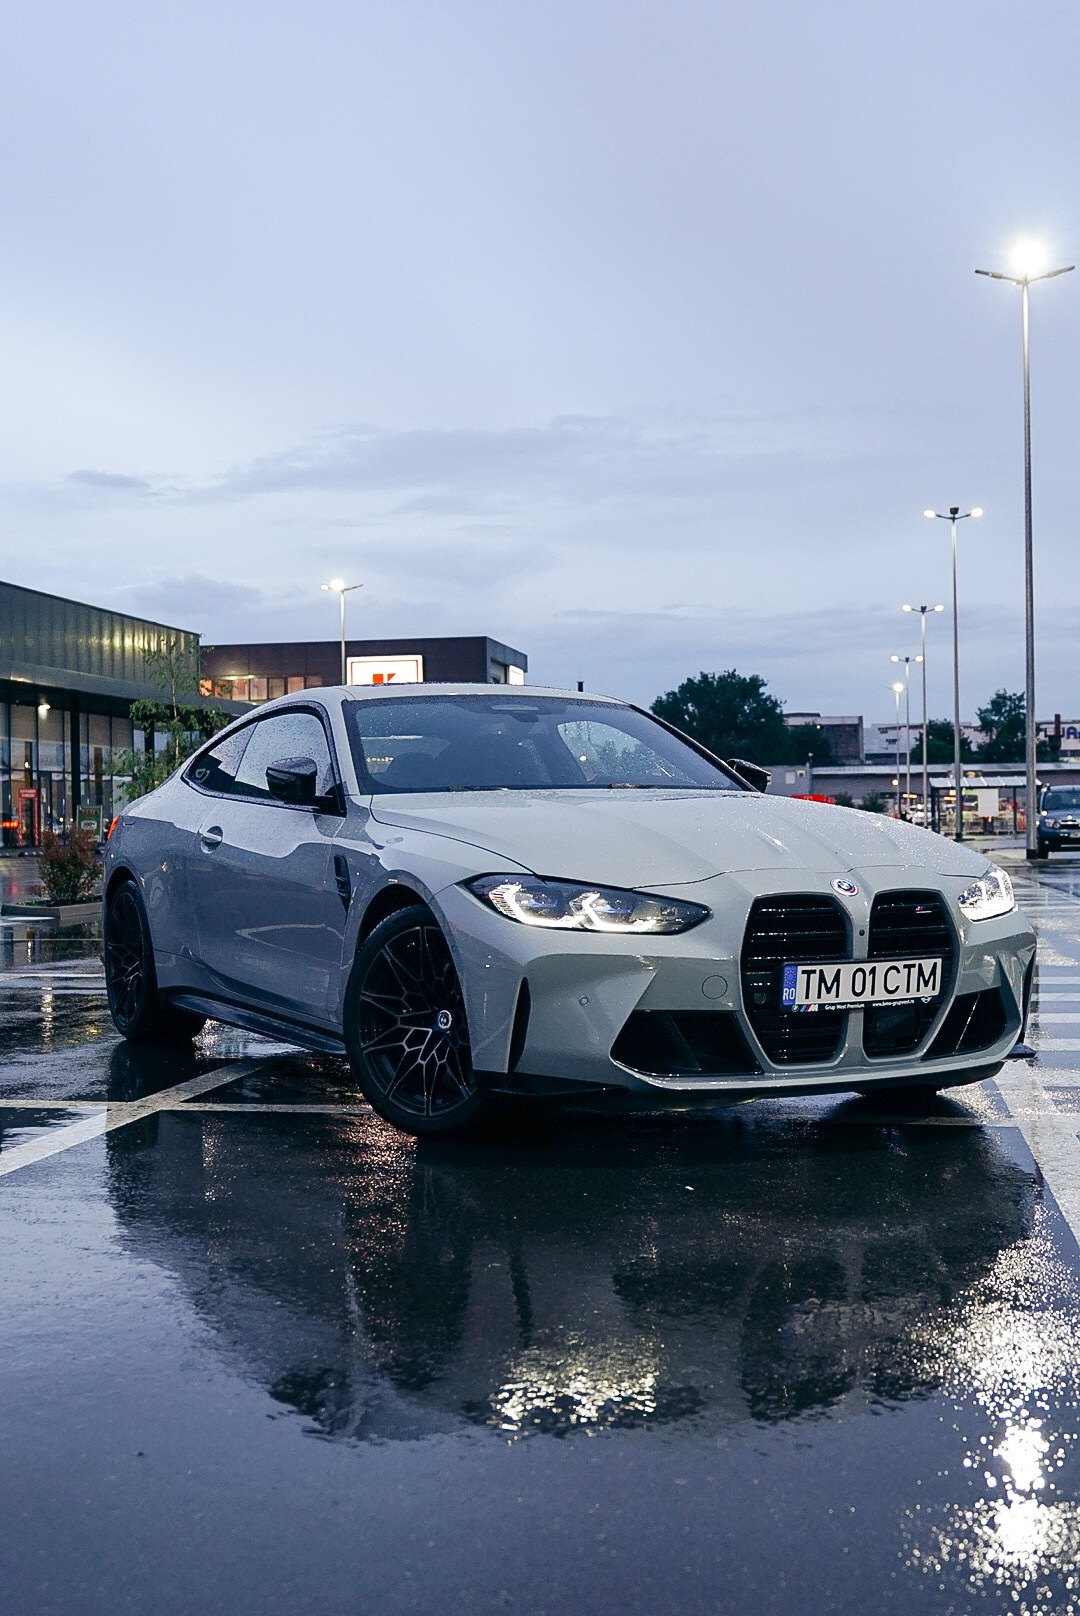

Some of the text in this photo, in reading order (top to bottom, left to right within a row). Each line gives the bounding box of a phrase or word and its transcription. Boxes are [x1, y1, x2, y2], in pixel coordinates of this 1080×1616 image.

[801, 961, 938, 999] TM 01 CTM
[783, 988, 796, 1000] RO
